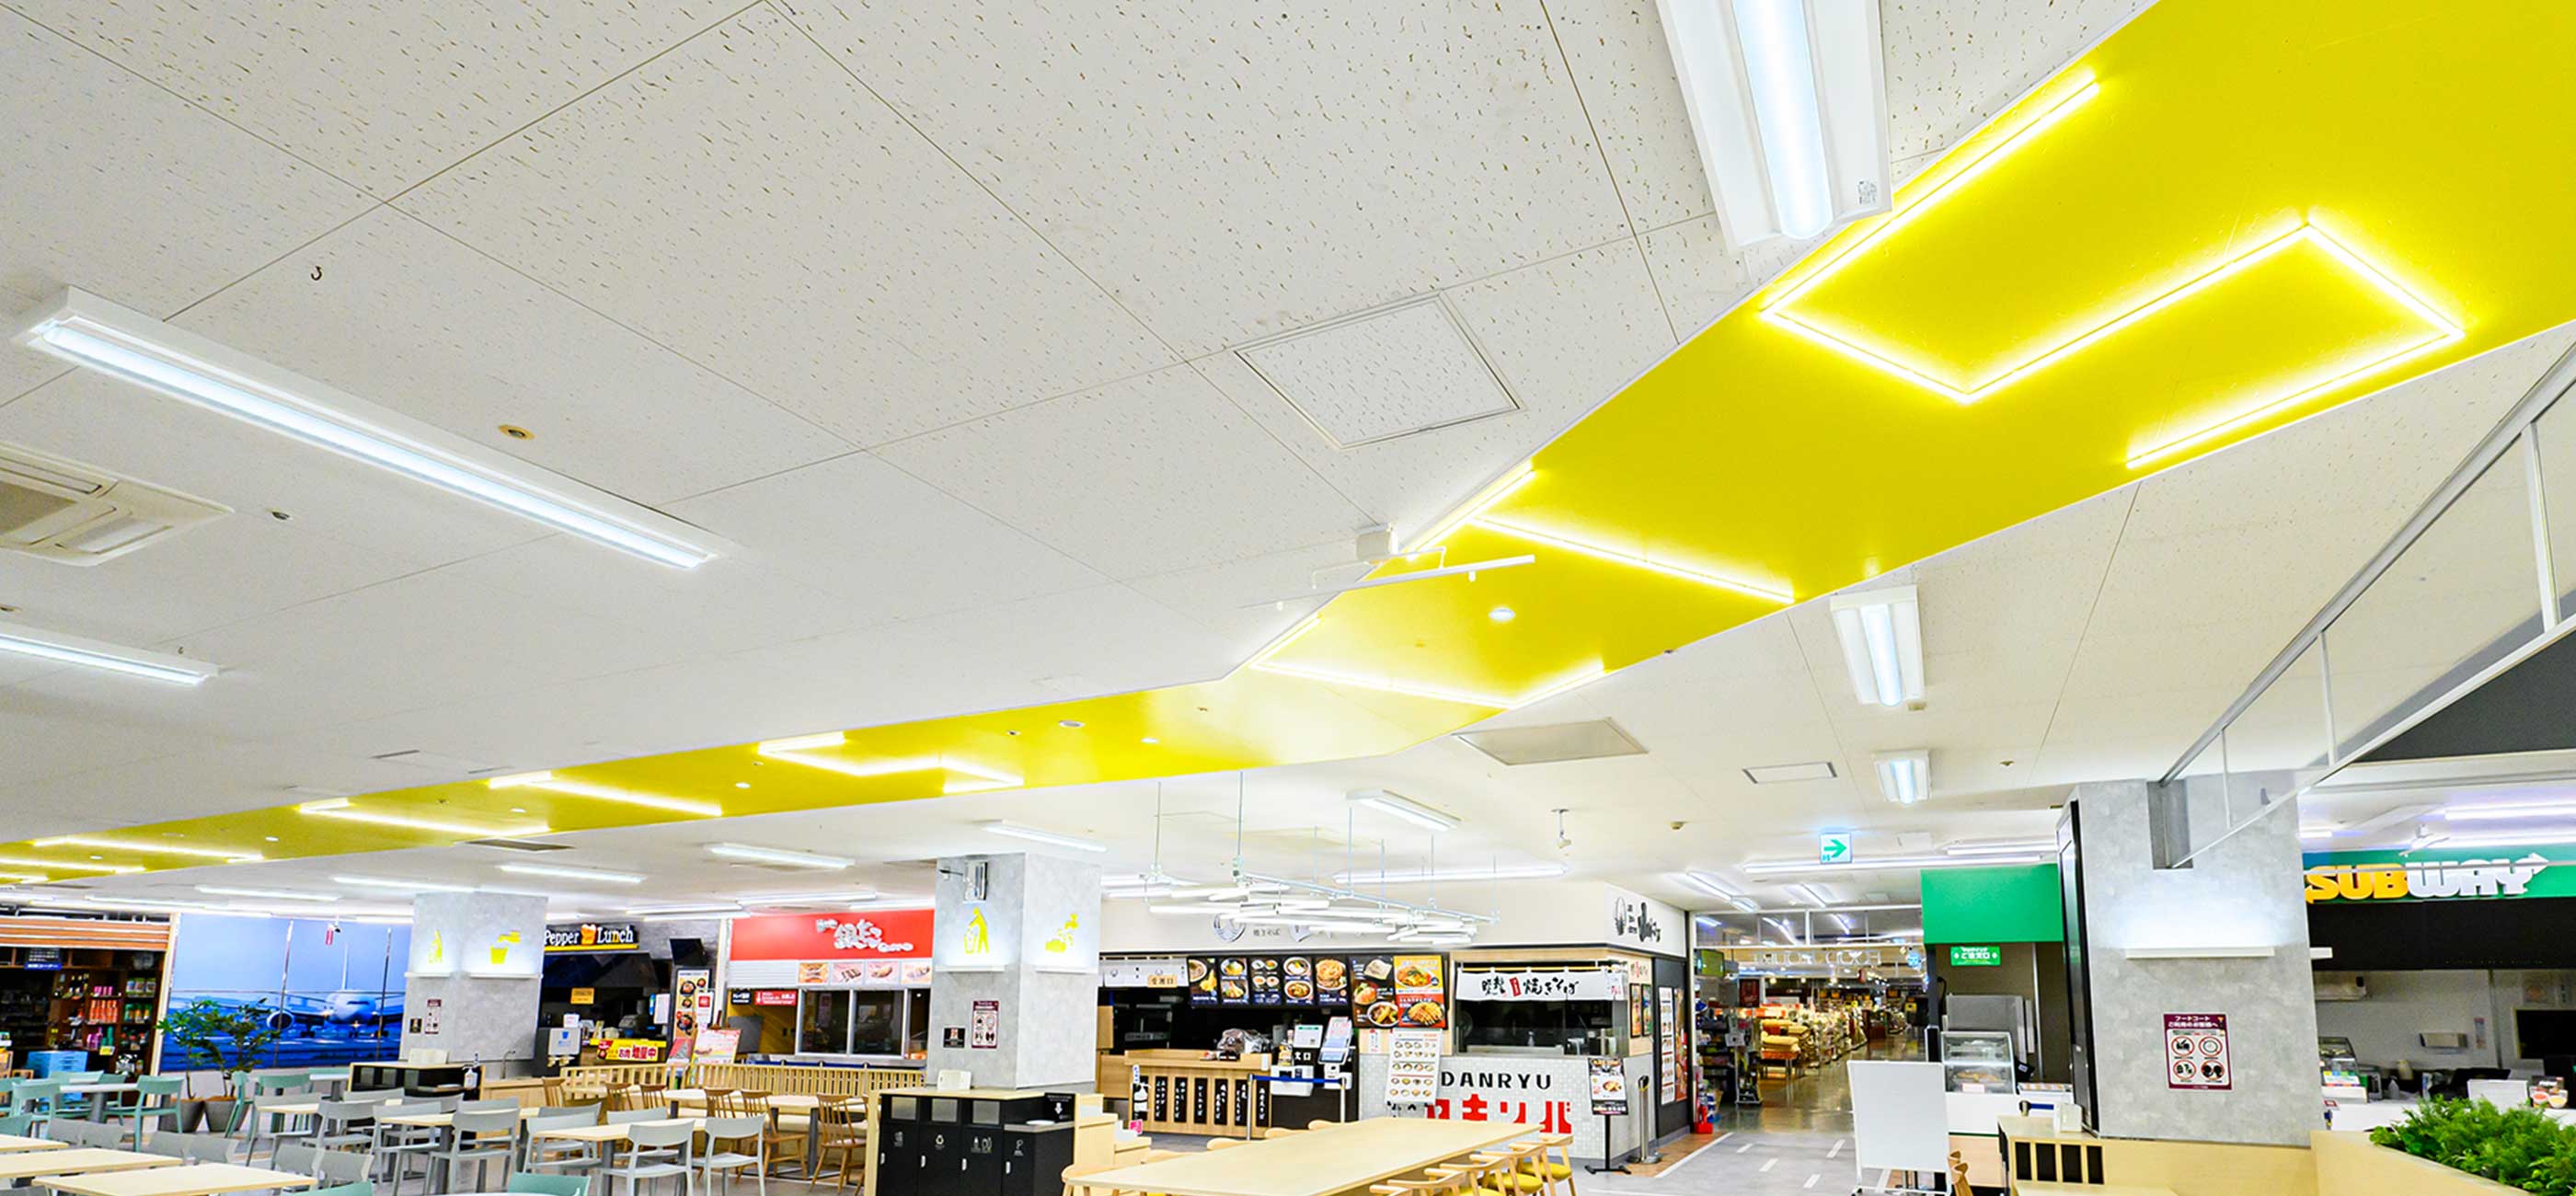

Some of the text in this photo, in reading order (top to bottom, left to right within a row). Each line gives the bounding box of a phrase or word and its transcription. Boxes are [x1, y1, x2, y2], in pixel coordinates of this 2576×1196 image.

[2304, 852, 2548, 904] SUBWAY
[545, 925, 634, 946] Pepper Lunch
[1523, 977, 1580, 995] 焼きそば
[1441, 1071, 1552, 1090] DANRYU
